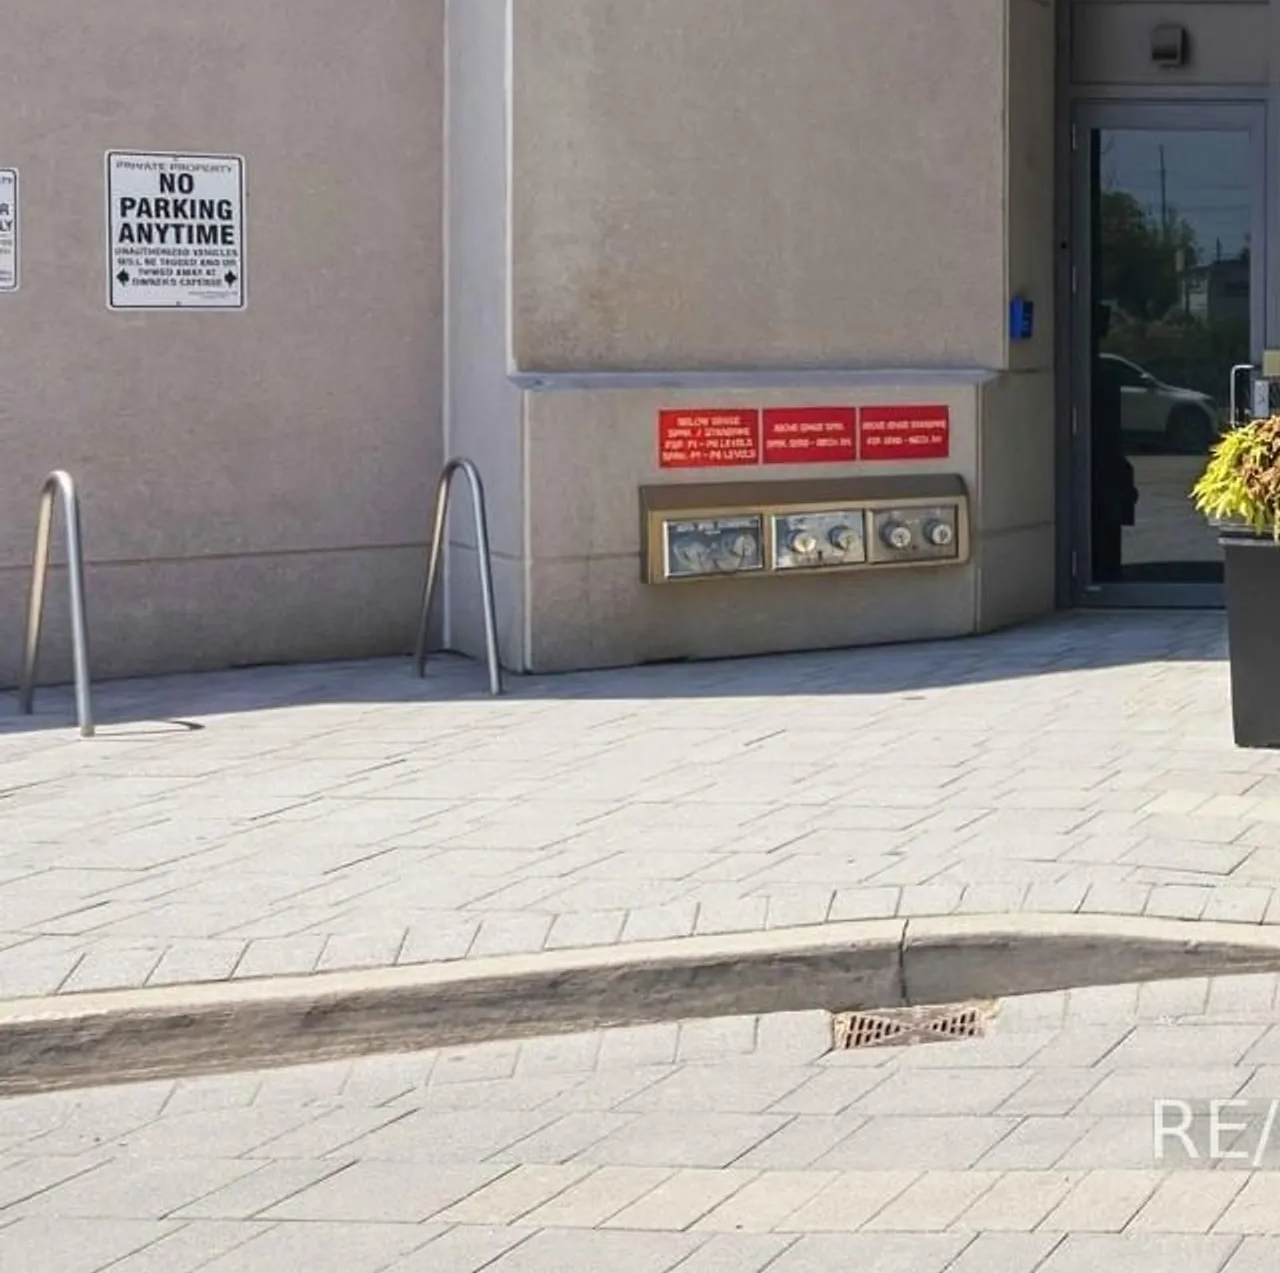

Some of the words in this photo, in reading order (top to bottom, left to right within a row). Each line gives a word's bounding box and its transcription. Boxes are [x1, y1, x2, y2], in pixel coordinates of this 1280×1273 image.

[159, 173, 195, 194] NO
[119, 197, 234, 221] PARKING
[118, 223, 236, 246] ANYTIME
